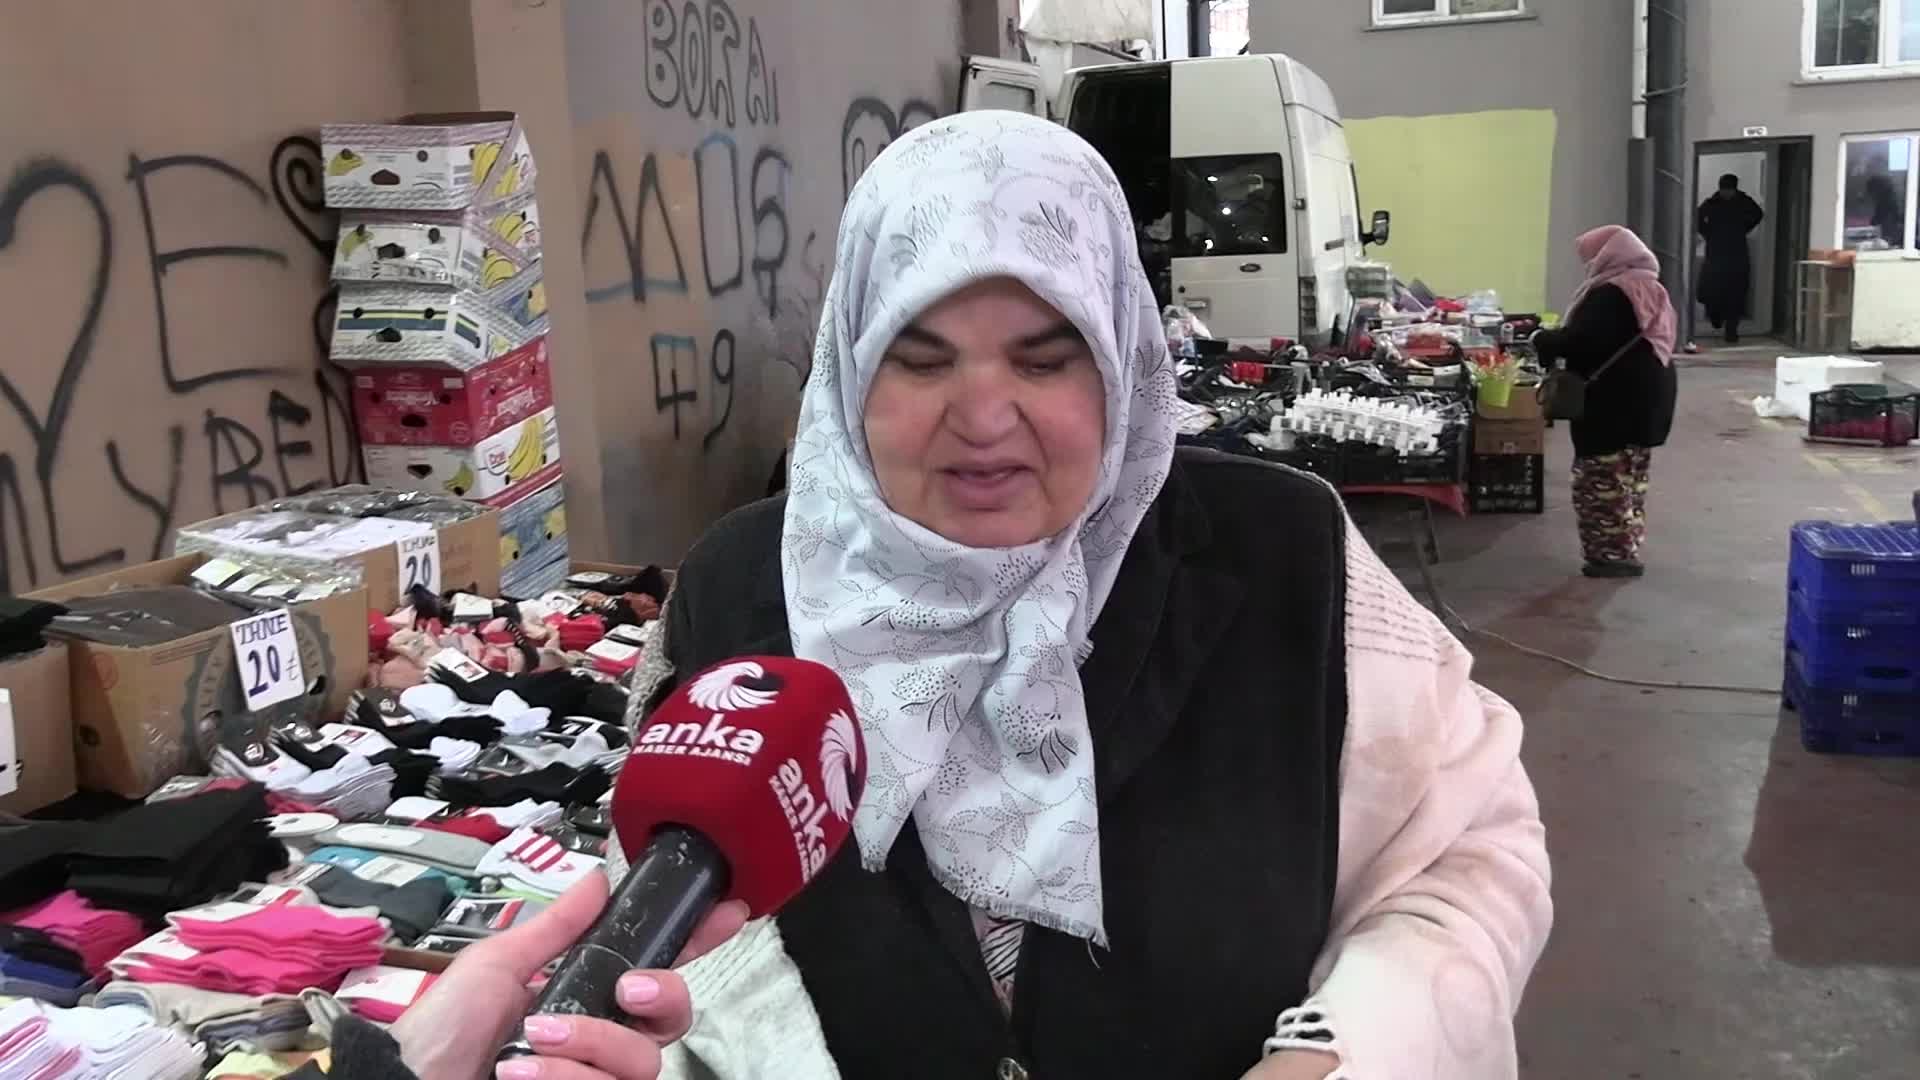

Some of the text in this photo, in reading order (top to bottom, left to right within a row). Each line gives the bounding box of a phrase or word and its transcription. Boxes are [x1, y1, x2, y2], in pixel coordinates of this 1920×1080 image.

[650, 328, 736, 449] 49
[405, 552, 433, 595] 20
[632, 744, 752, 766] HABER AJANSI
[641, 713, 764, 754] anka
[778, 758, 827, 878] anka
